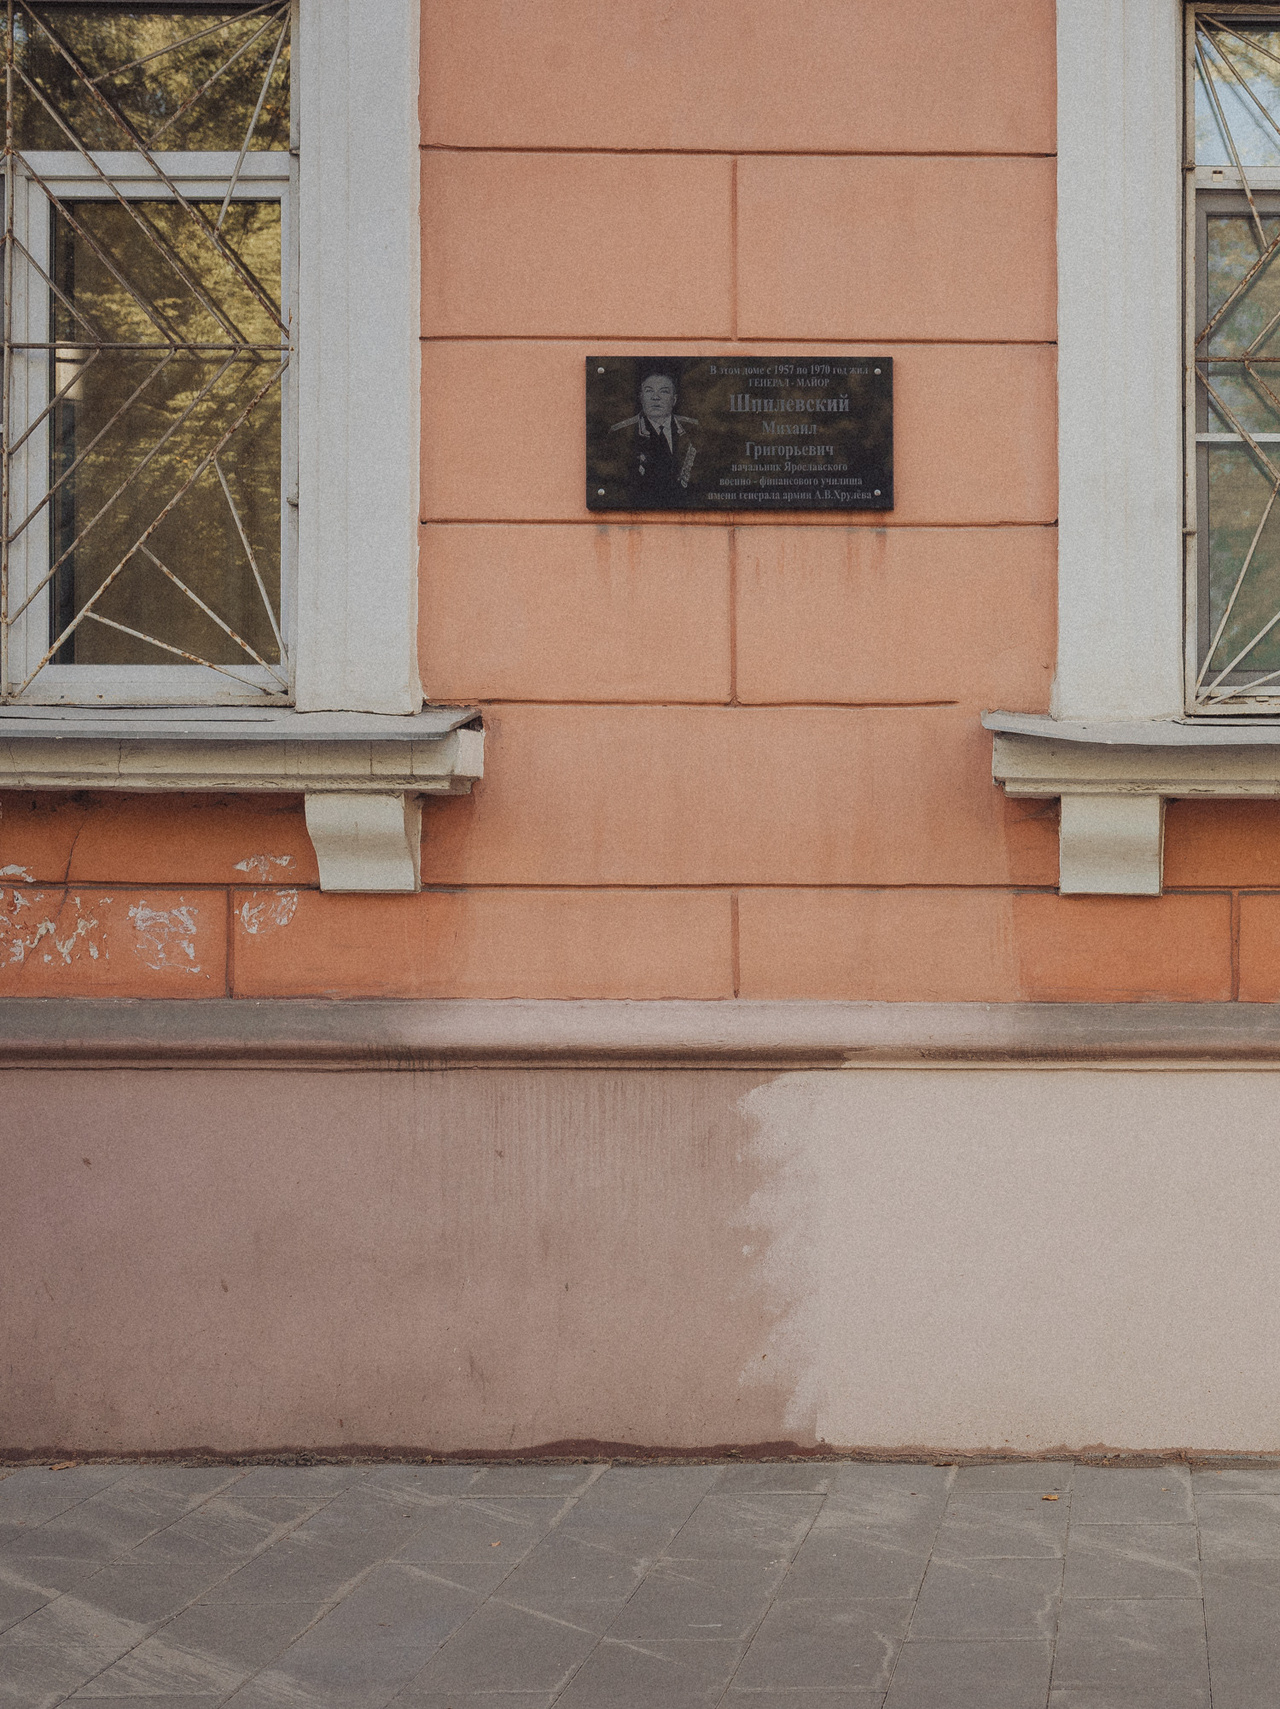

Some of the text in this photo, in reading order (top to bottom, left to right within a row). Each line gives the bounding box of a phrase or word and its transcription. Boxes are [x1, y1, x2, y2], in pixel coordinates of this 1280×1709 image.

[710, 366, 716, 374] В
[742, 367, 764, 376] доме
[774, 365, 793, 374] 1957
[811, 364, 830, 374] 1970
[833, 367, 847, 375] год
[749, 379, 789, 387] ГЕНЕРАЛ
[797, 377, 830, 387] МАЙОР
[730, 394, 850, 412] Шпилевский
[762, 421, 817, 435] Михаил
[746, 442, 833, 459] Григорьевич
[732, 462, 847, 473] начальник Ярославского
[759, 476, 818, 488] финансового
[821, 478, 862, 488] училища
[739, 492, 780, 501] генерала
[783, 492, 810, 501] армии
